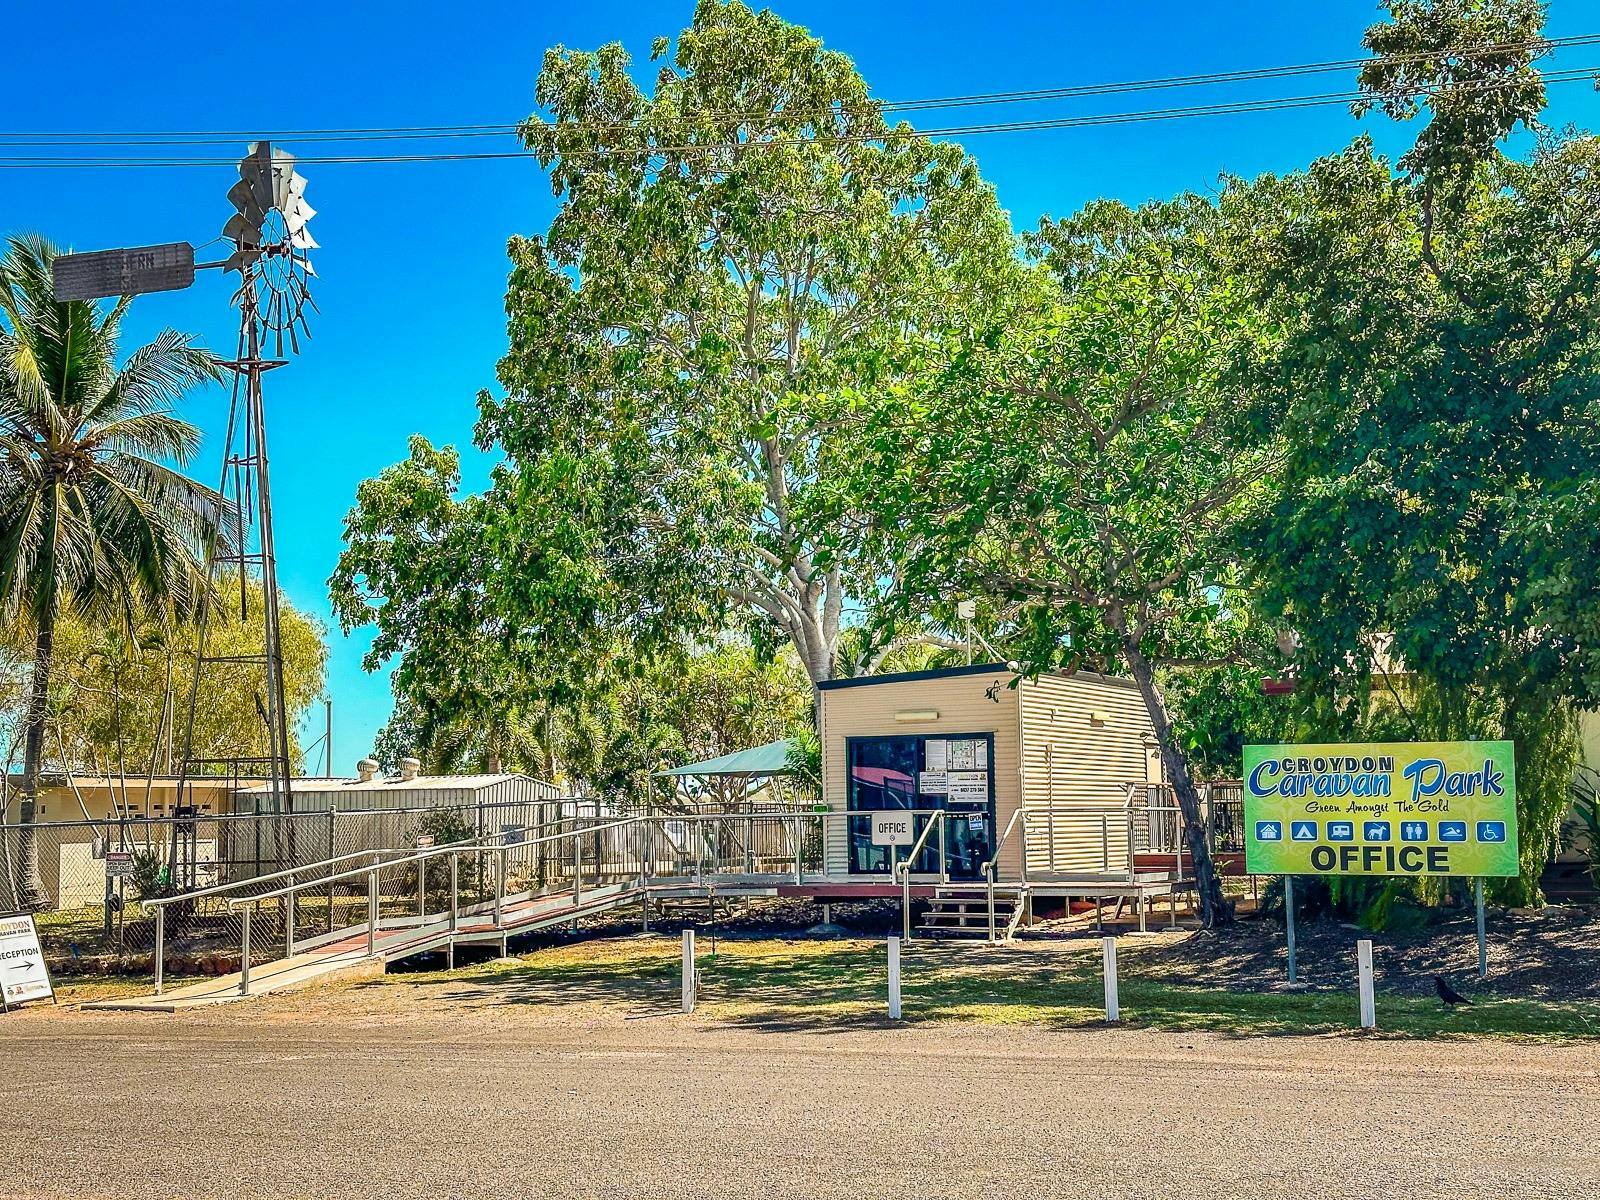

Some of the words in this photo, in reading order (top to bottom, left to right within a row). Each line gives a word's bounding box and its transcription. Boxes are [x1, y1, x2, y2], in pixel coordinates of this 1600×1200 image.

[1281, 756, 1394, 773] CROYDON
[1248, 759, 1391, 798] Caravan
[1403, 758, 1504, 802] Park
[1305, 801, 1341, 813] Green
[1345, 801, 1389, 817] Amongst
[1394, 801, 1414, 812] The
[1417, 800, 1449, 812] Gold
[878, 822, 907, 834] OFFICE
[1311, 846, 1450, 872] OFFICE
[0, 920, 30, 932] OYDON
